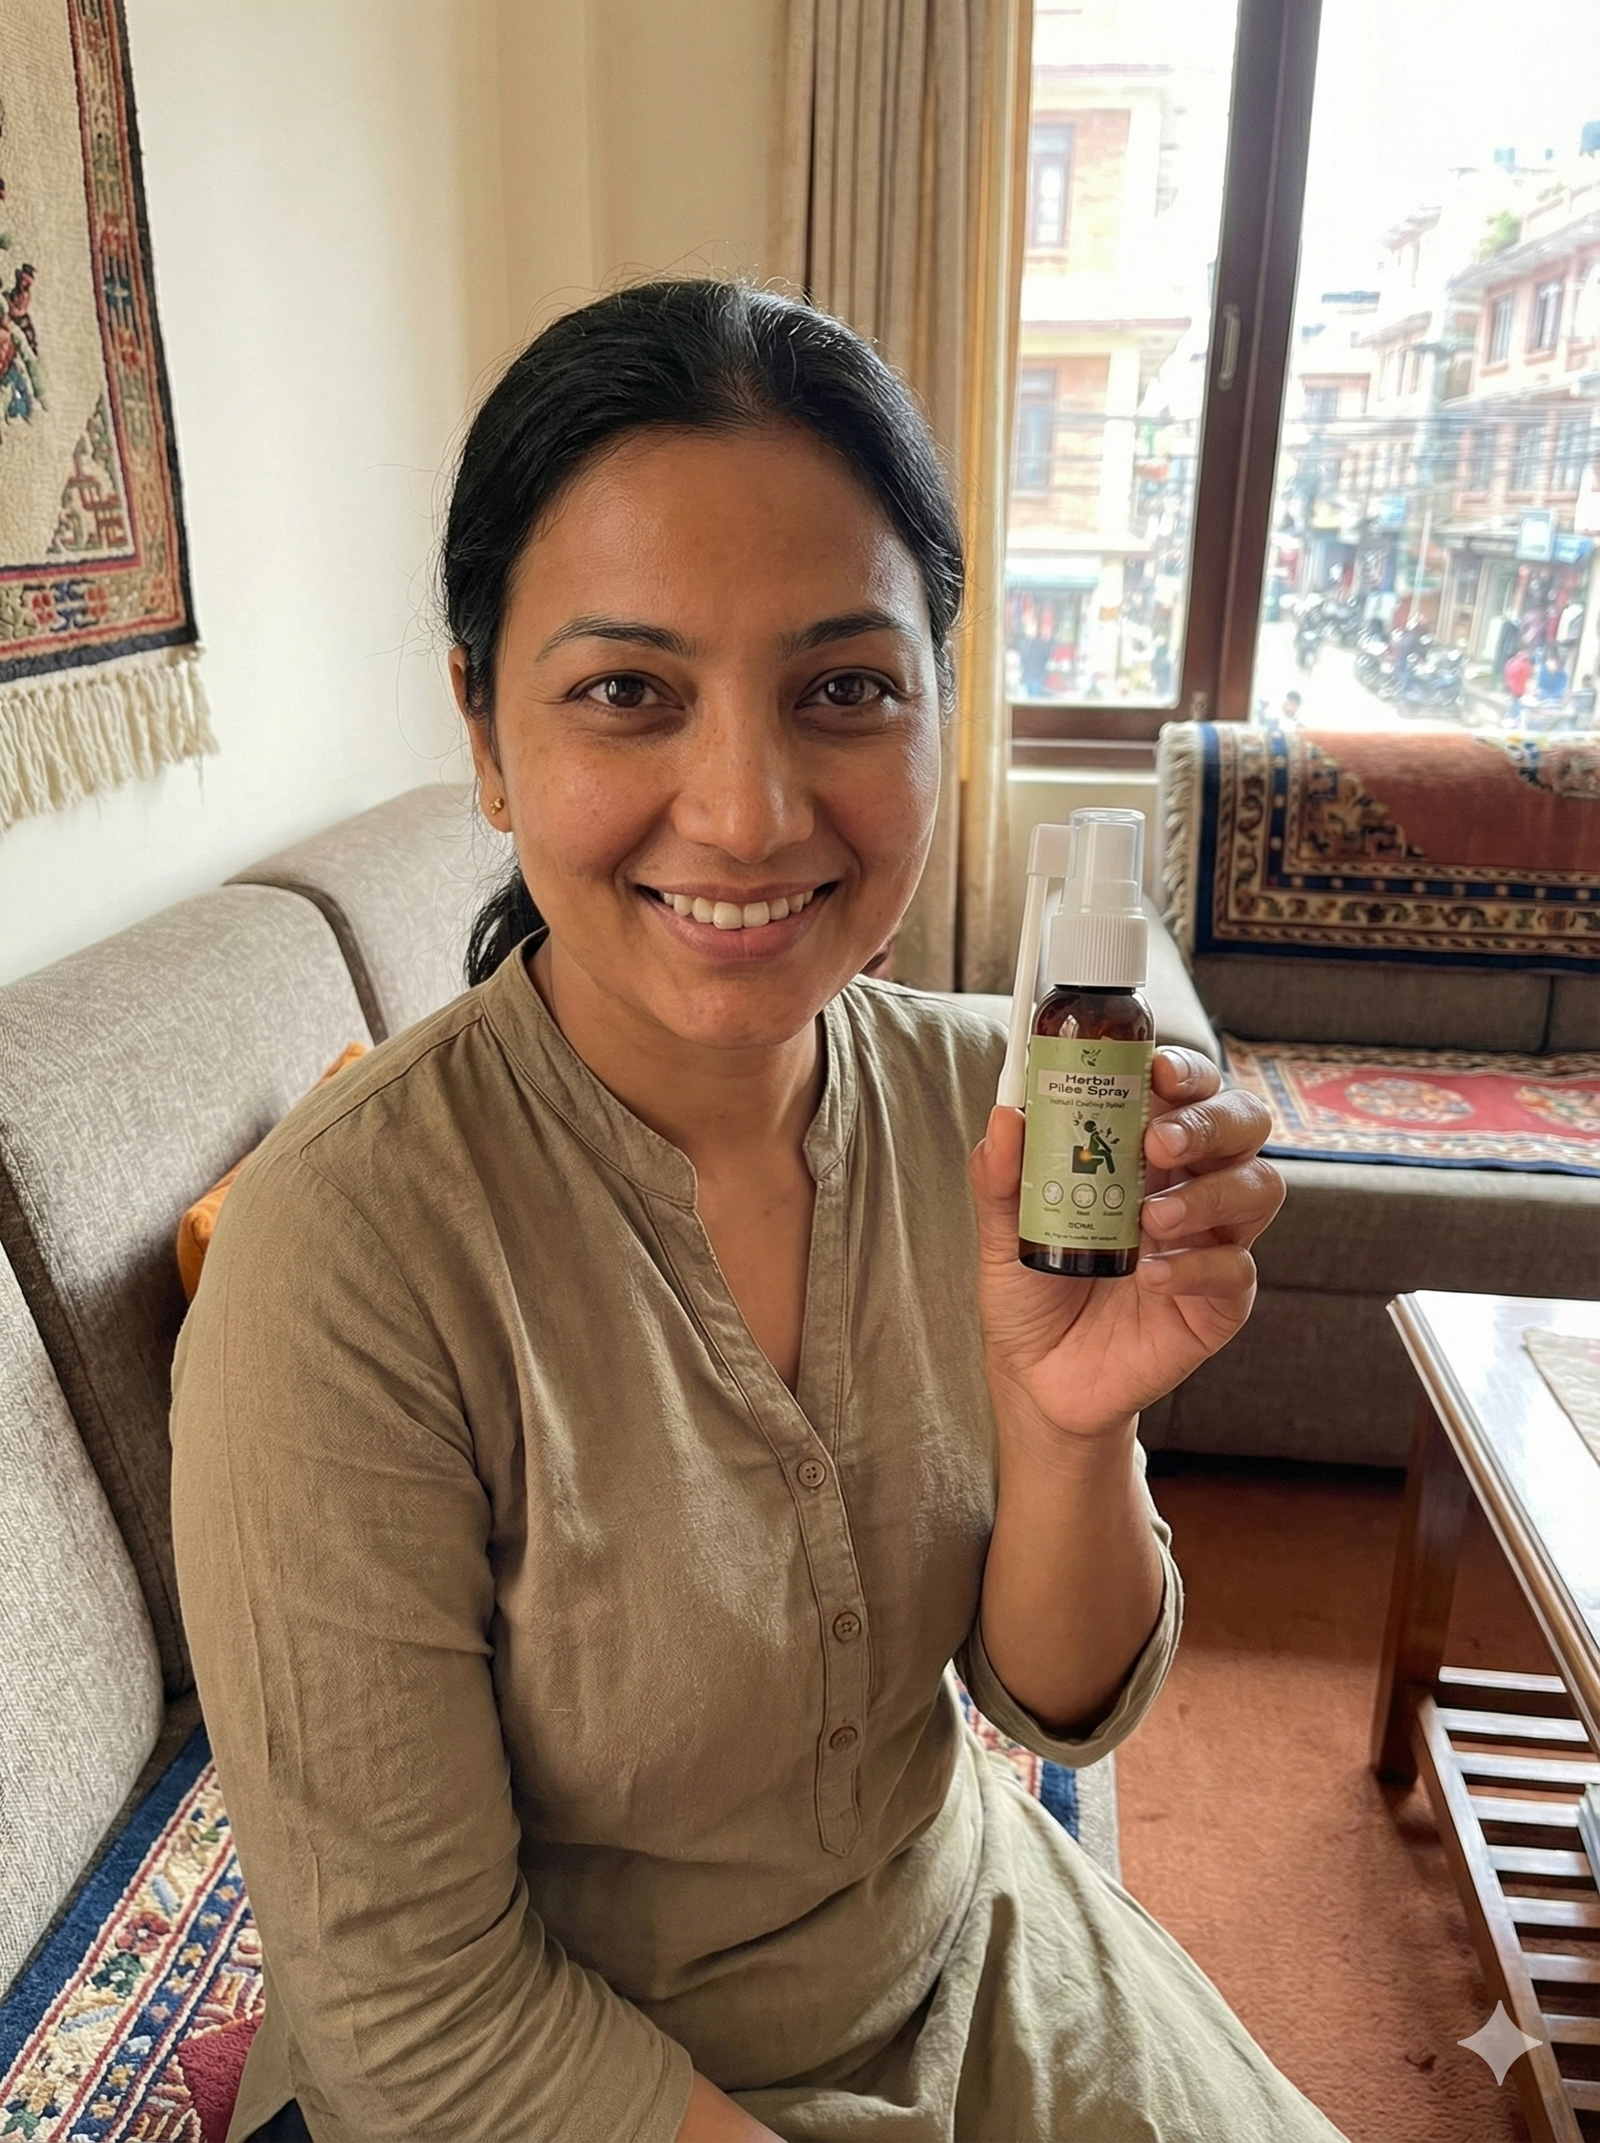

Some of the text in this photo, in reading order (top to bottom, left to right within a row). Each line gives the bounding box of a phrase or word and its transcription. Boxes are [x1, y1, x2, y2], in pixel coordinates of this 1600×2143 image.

[1065, 1074, 1115, 1086] Herbal
[1049, 1082, 1130, 1098] Pilee Spray
